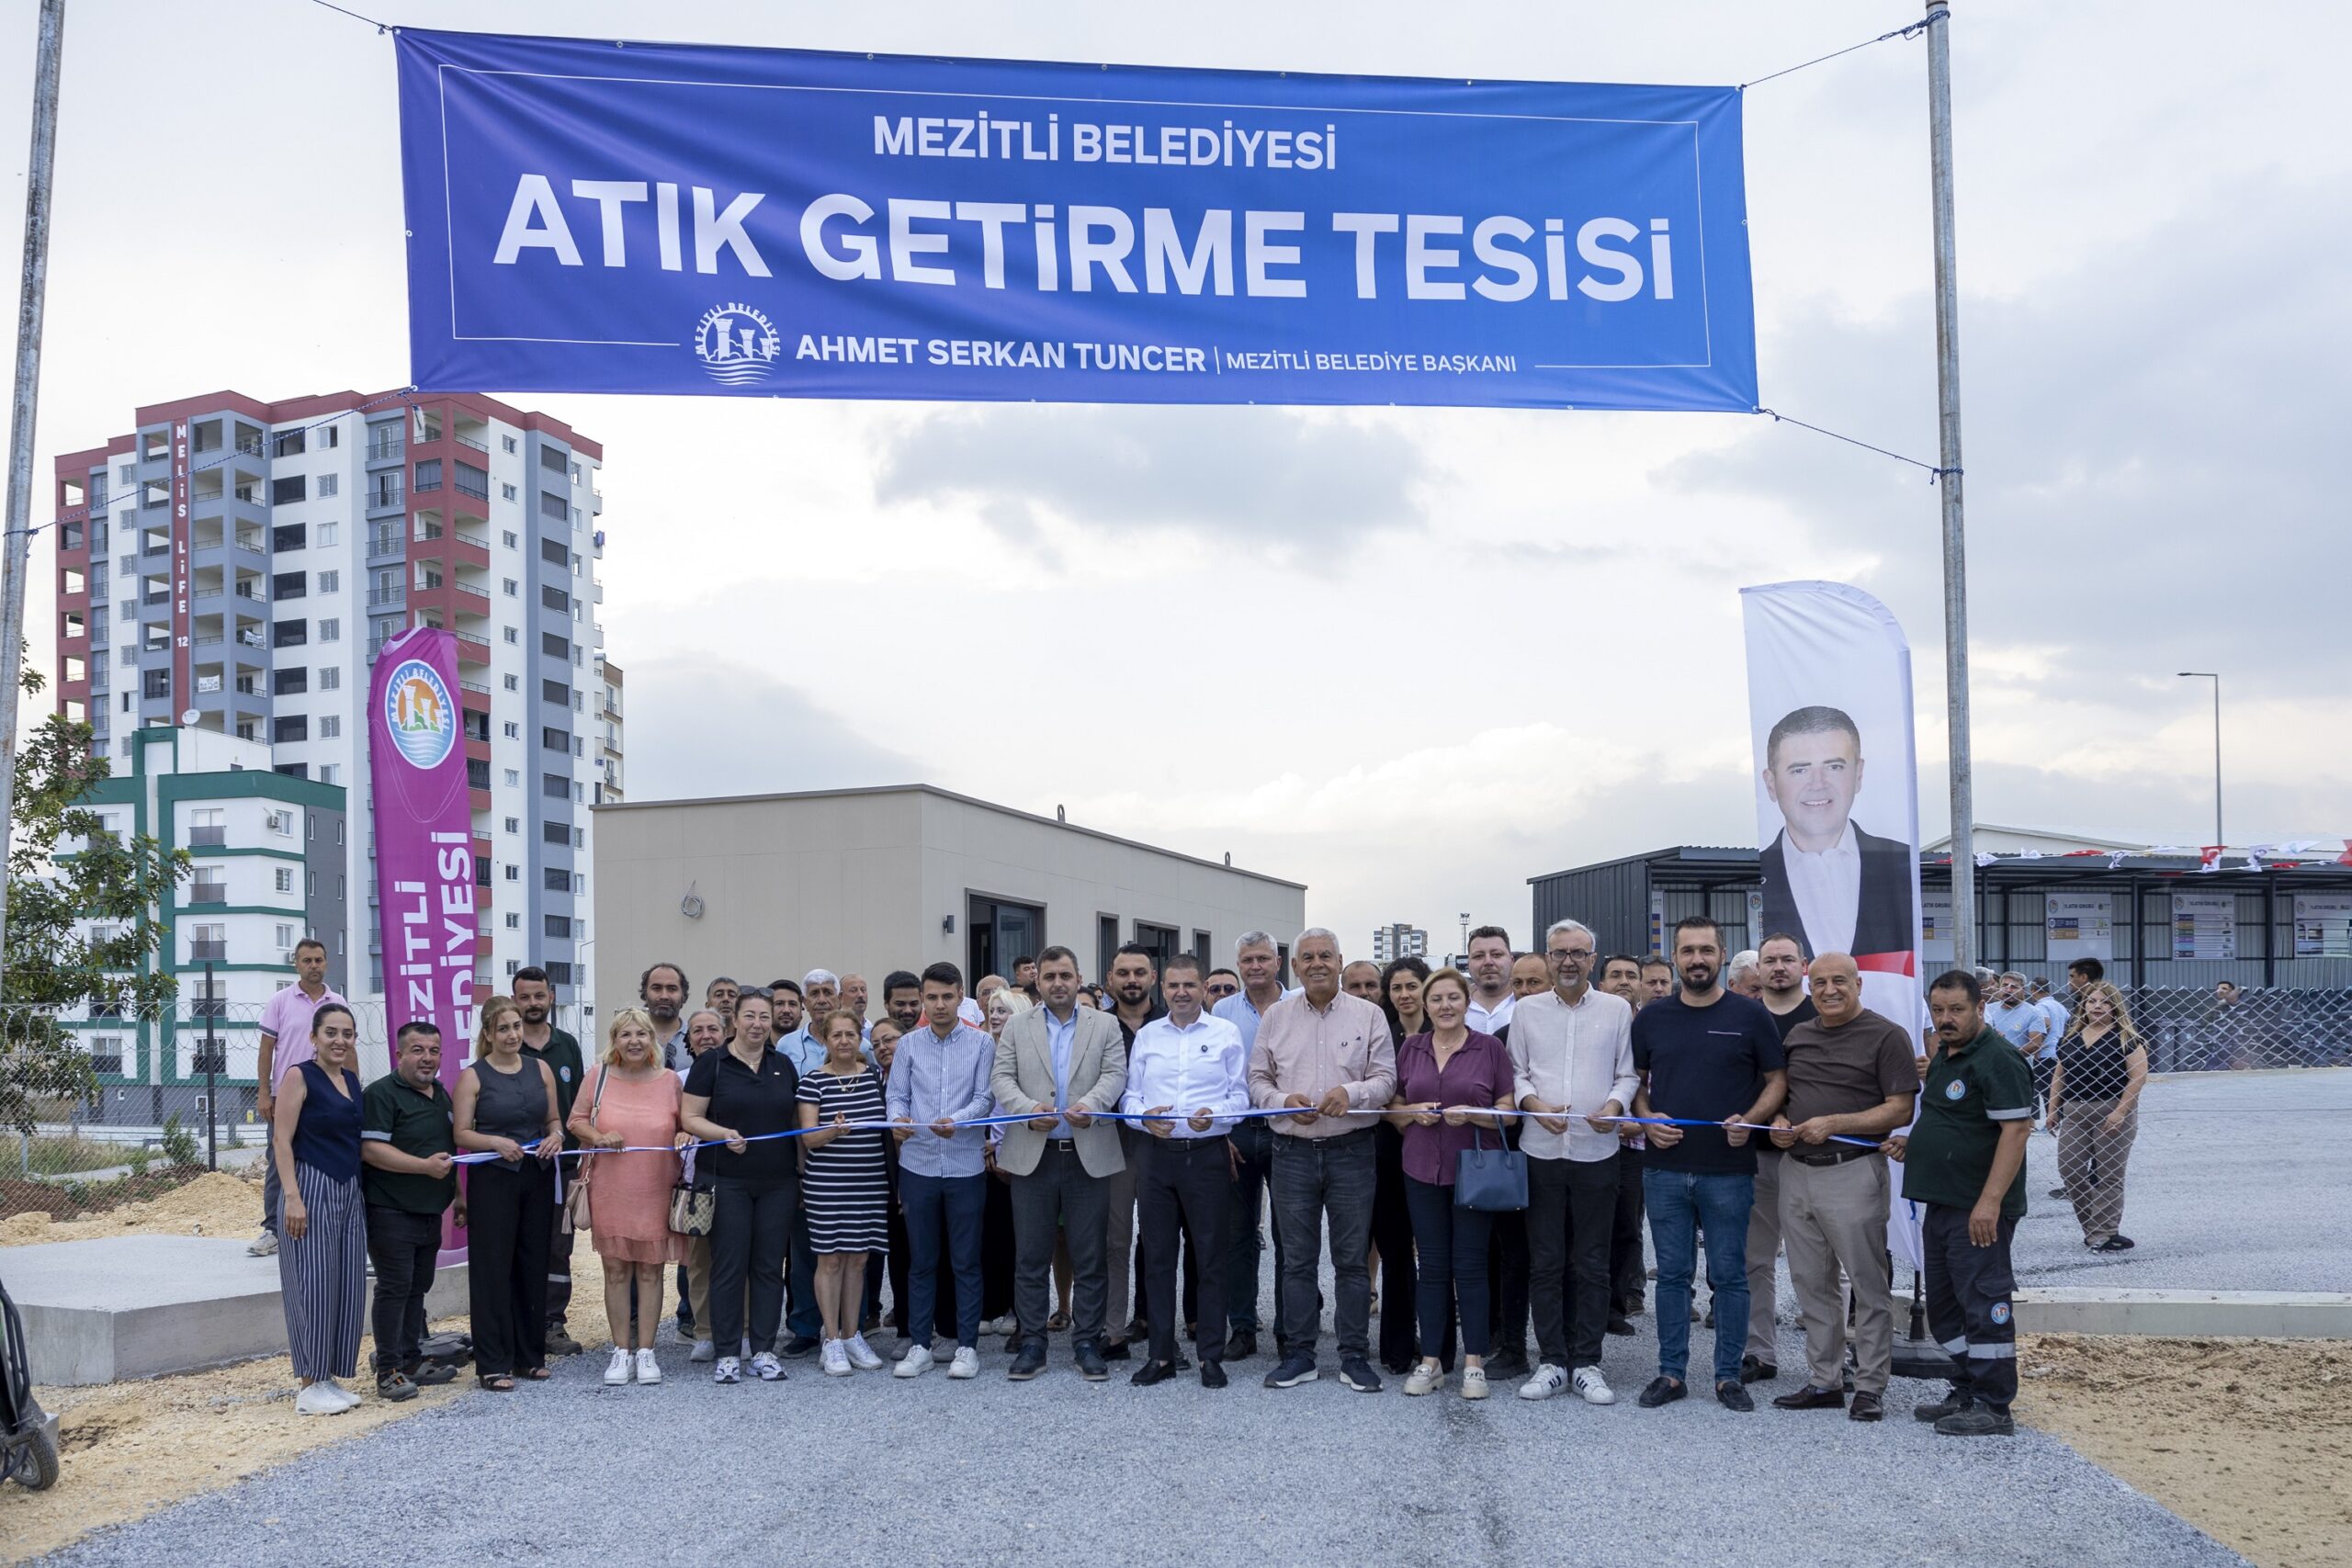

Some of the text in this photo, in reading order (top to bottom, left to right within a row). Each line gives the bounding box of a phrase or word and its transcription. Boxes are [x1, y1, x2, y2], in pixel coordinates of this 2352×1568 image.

[874, 110, 1336, 170] MEZİTLİ BELEDİYESİ
[493, 174, 1674, 302] ATIK GETİRME TESİSİ
[796, 334, 1517, 375] AHMET SERKAN TUNCER MEZİTLİ BELEDİYE BAŞKANI
[177, 636, 188, 648] 12
[393, 881, 436, 1026] ZİTLİ
